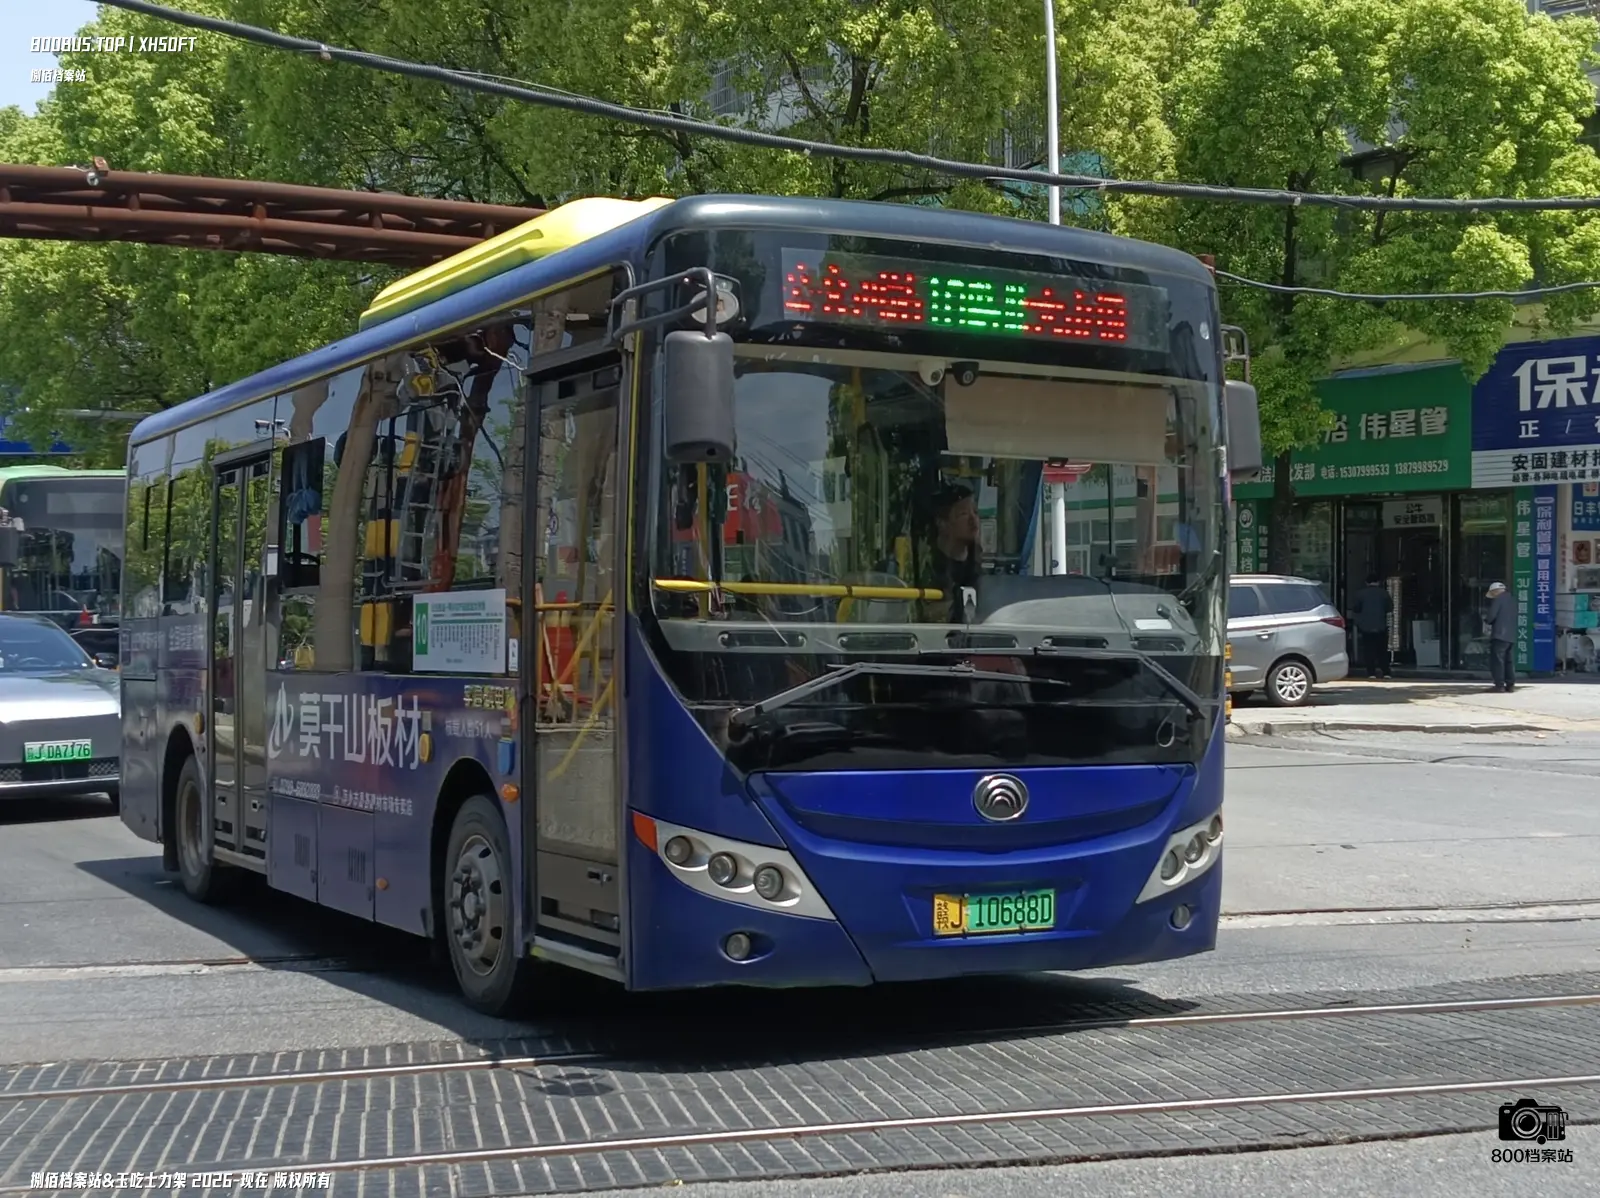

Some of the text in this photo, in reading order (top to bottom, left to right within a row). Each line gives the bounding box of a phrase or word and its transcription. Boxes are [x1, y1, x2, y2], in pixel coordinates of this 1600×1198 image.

[1358, 405, 1449, 441] 伟星管
[1519, 420, 1540, 438] 正
[299, 692, 421, 770] 莫干山板材
